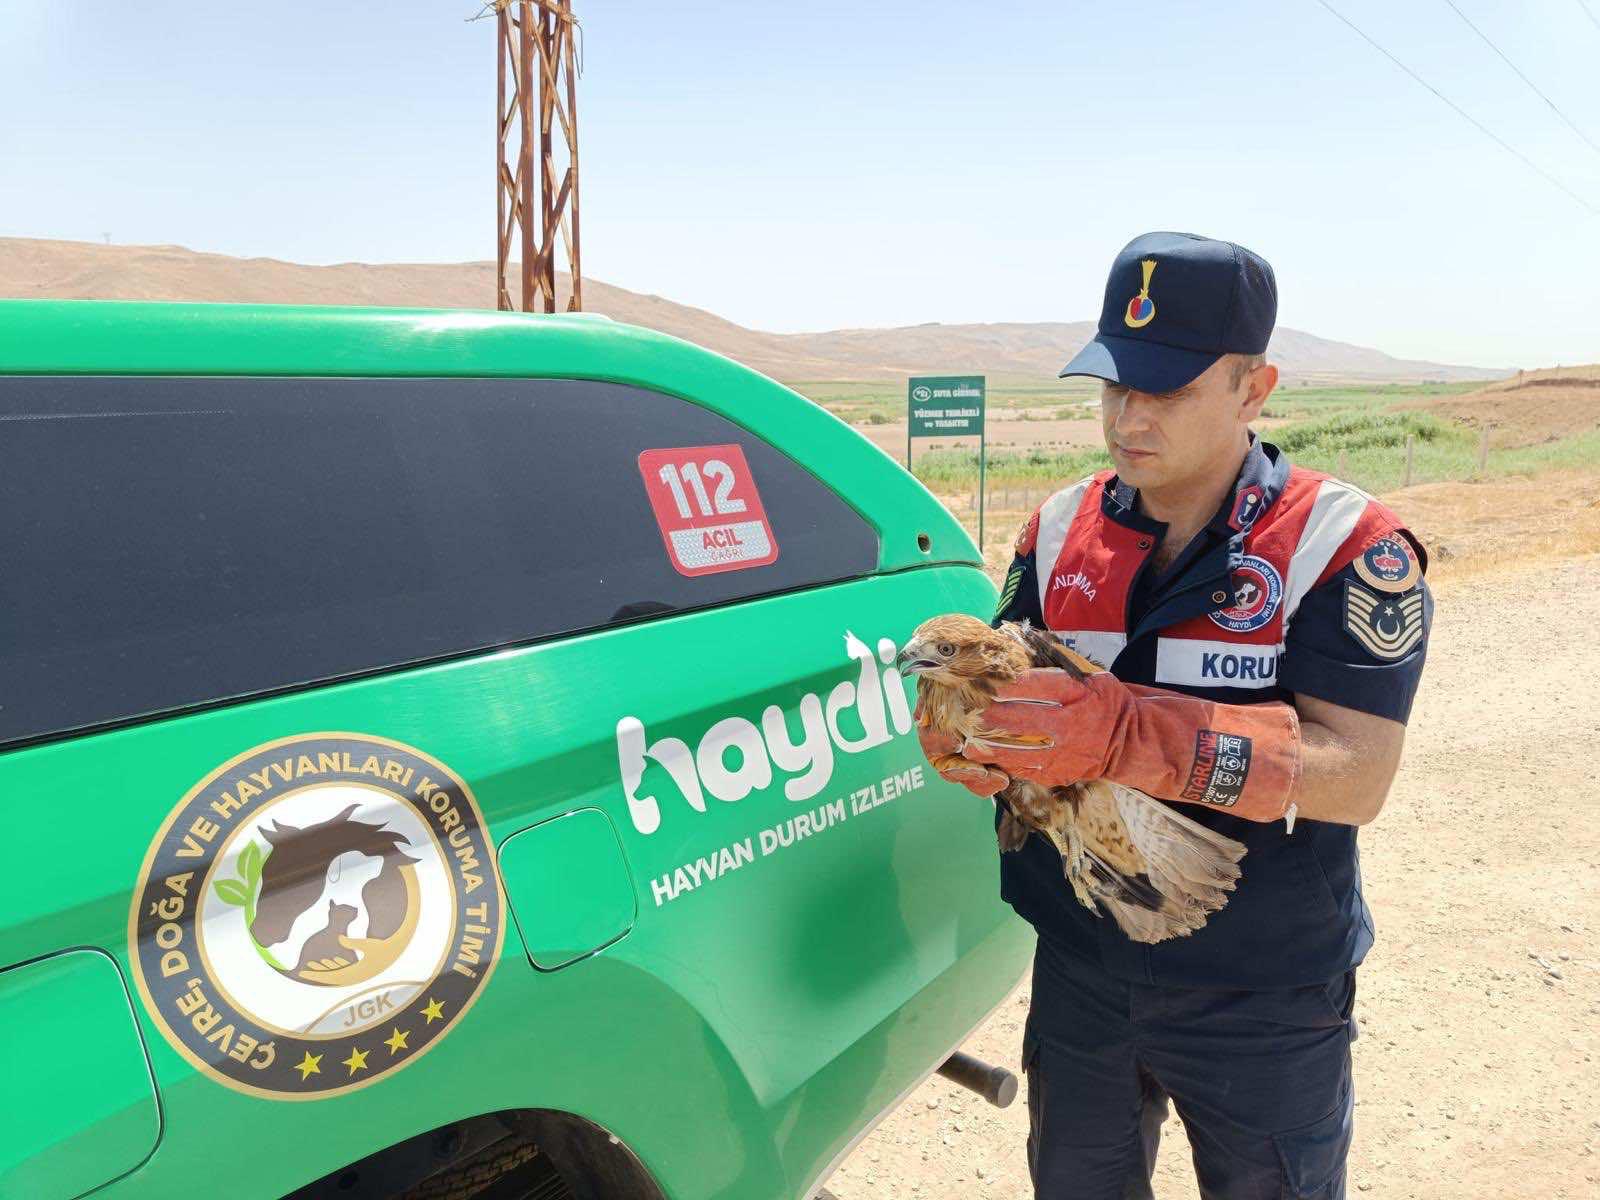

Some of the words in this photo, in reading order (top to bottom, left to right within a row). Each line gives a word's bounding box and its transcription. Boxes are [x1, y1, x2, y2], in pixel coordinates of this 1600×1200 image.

[658, 459, 747, 519] 112
[1202, 652, 1280, 680] KORU
[616, 630, 912, 835] haydi
[1185, 732, 1217, 800] STARLINE
[150, 871, 194, 977] DOĞA
[176, 816, 221, 859] VE
[210, 752, 414, 820] HAYVANLARI
[415, 777, 483, 894] KORUMA
[453, 902, 491, 979] TİMİ
[650, 838, 753, 907] HAYVAN
[759, 799, 847, 856] DURUM
[849, 766, 925, 817] İZLEME
[343, 990, 394, 1029] JGK
